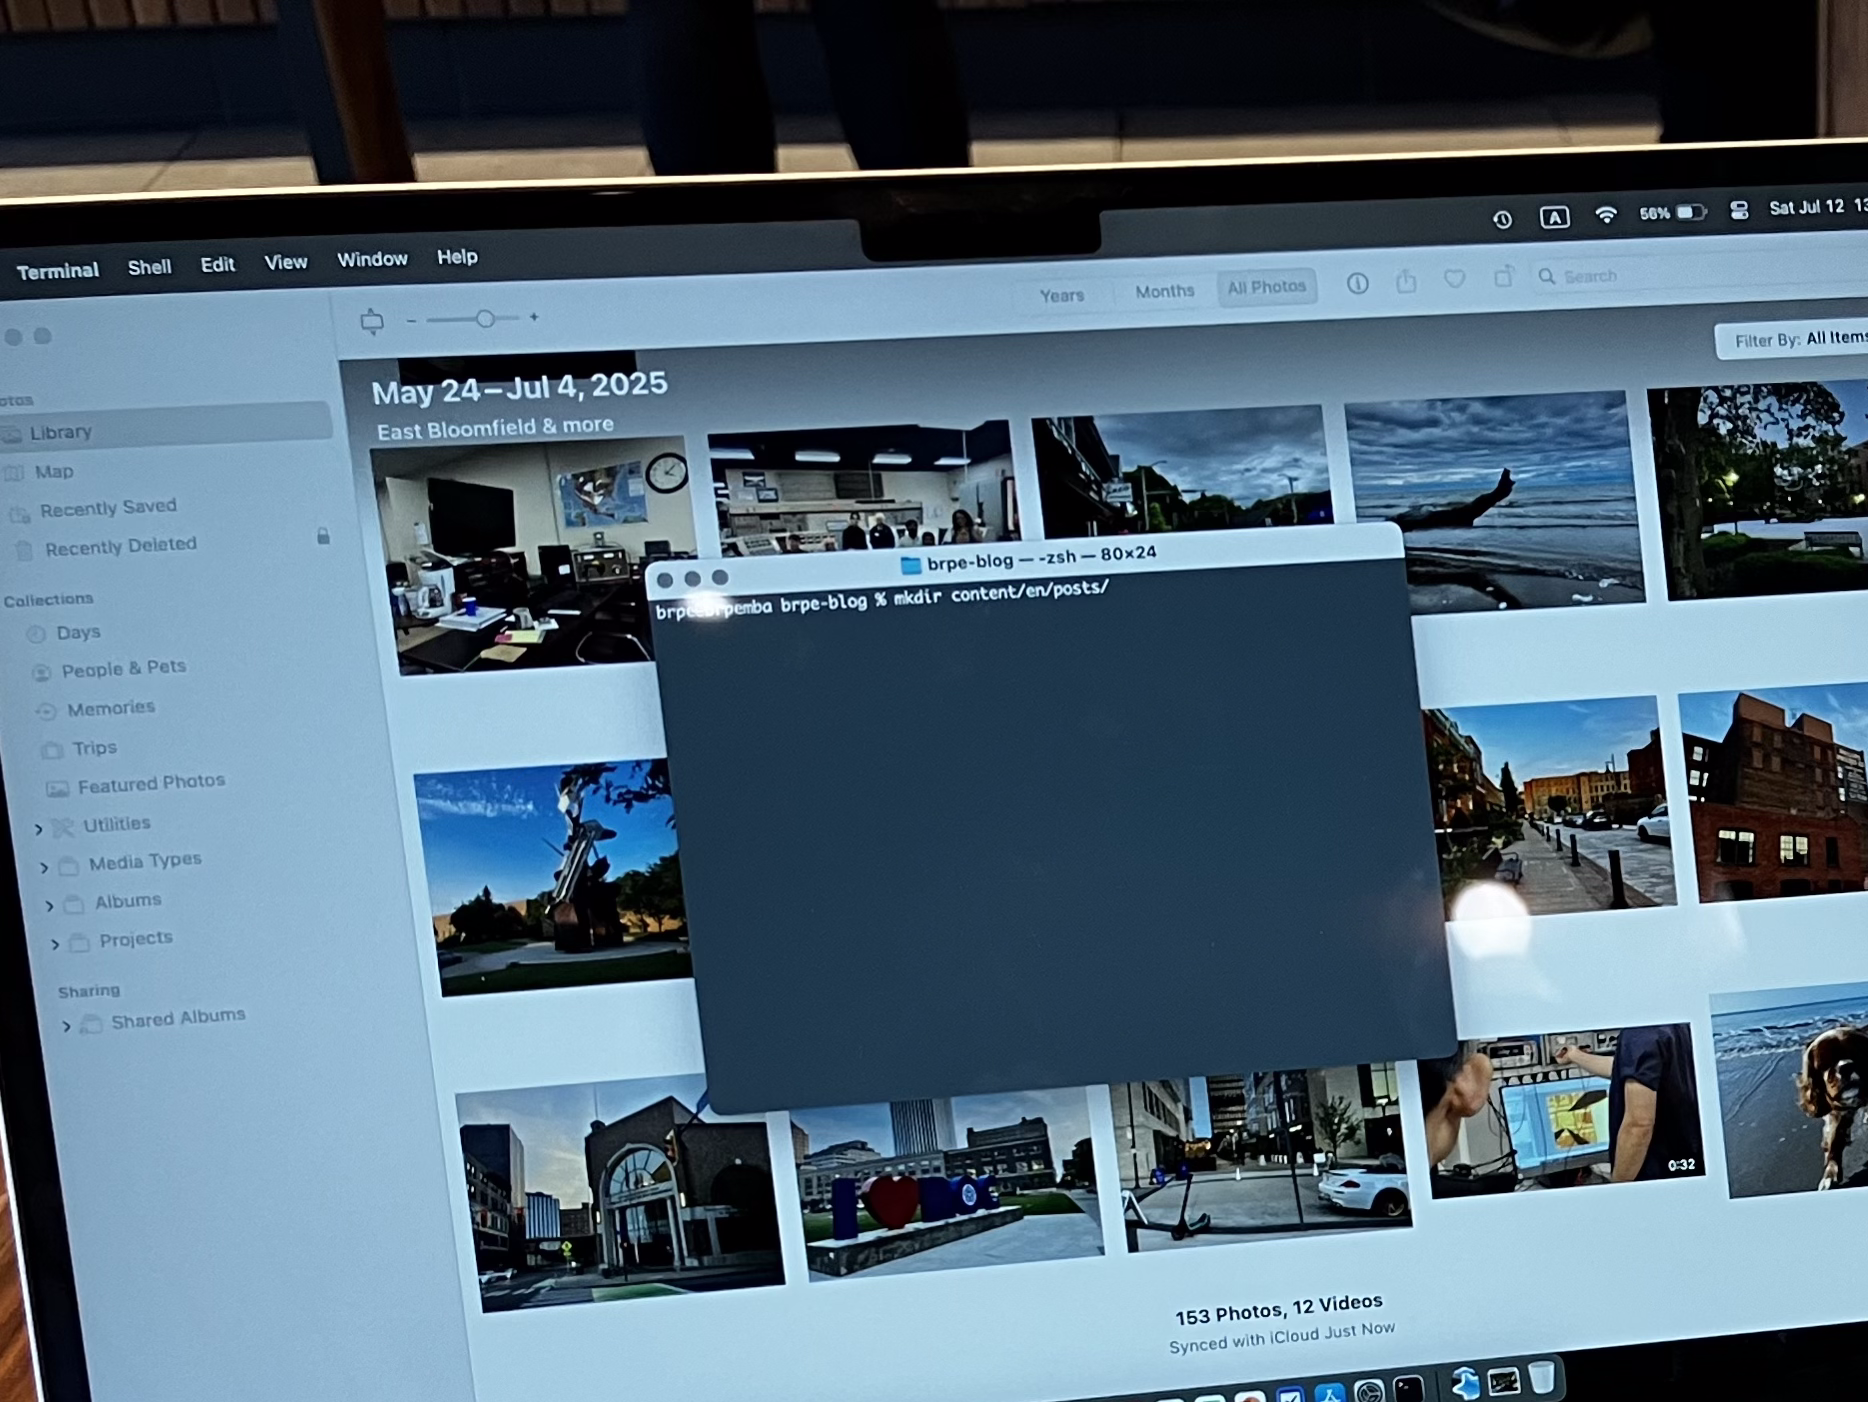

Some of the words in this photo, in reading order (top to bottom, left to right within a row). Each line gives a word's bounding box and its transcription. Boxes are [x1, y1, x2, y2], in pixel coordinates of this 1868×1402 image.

[1770, 200, 1794, 215] Sat
[1799, 199, 1820, 214] Jul
[1825, 198, 1845, 213] 12
[17, 262, 99, 281] Terminal
[128, 258, 172, 276] Shell
[200, 256, 236, 273] Edit
[264, 253, 308, 271] View
[337, 250, 409, 269] Window
[437, 248, 479, 269] Help
[1565, 269, 1617, 284] Search
[1136, 283, 1195, 299] Months
[1228, 279, 1247, 295] All
[1251, 277, 1307, 294] Photos
[1040, 288, 1085, 303] Years
[1736, 333, 1773, 349] Filter
[1778, 332, 1801, 349] By:
[1807, 330, 1827, 345] All
[371, 379, 435, 409] May
[557, 375, 585, 402] 4,
[592, 371, 668, 395] 2025
[30, 423, 92, 442] Library
[377, 422, 423, 441] East
[427, 417, 537, 439] Bloomfield
[542, 417, 558, 435] &
[563, 418, 614, 433] more
[35, 464, 74, 481] Map
[41, 500, 117, 519] Recently
[123, 497, 177, 515] Saved
[45, 538, 122, 557] Recently
[128, 534, 197, 553] Deleted
[927, 554, 1014, 572] brpe-blog
[3, 593, 94, 608] Collections
[781, 593, 868, 613] brpe-blog
[874, 592, 888, 608] %
[894, 587, 942, 605] mkdir
[951, 578, 1111, 601] content/en/posts/
[57, 625, 101, 643] Days
[62, 663, 123, 678] People
[129, 661, 142, 675] &
[147, 659, 187, 674] Pets
[68, 700, 155, 717] Memories
[73, 741, 118, 757] Trips
[79, 776, 158, 794] Featured
[163, 773, 226, 790] Photos
[84, 816, 151, 833] Utilities
[89, 855, 144, 871] Media
[149, 852, 202, 869] Types
[95, 893, 162, 910] Albums
[100, 930, 173, 947] Projects
[58, 984, 120, 999] Sharing
[112, 1012, 174, 1030] Shared
[181, 1008, 246, 1025] Albums
[1668, 1158, 1696, 1170] 0:32
[1176, 1308, 1211, 1327] 153
[1216, 1303, 1288, 1323] Photos,
[1293, 1298, 1314, 1316] 12
[1319, 1292, 1383, 1313] Videos
[1169, 1336, 1228, 1355] Synced
[1232, 1331, 1265, 1347] with
[1270, 1326, 1320, 1345] iCloud
[1324, 1324, 1357, 1340] Just
[1362, 1320, 1396, 1336] Now
